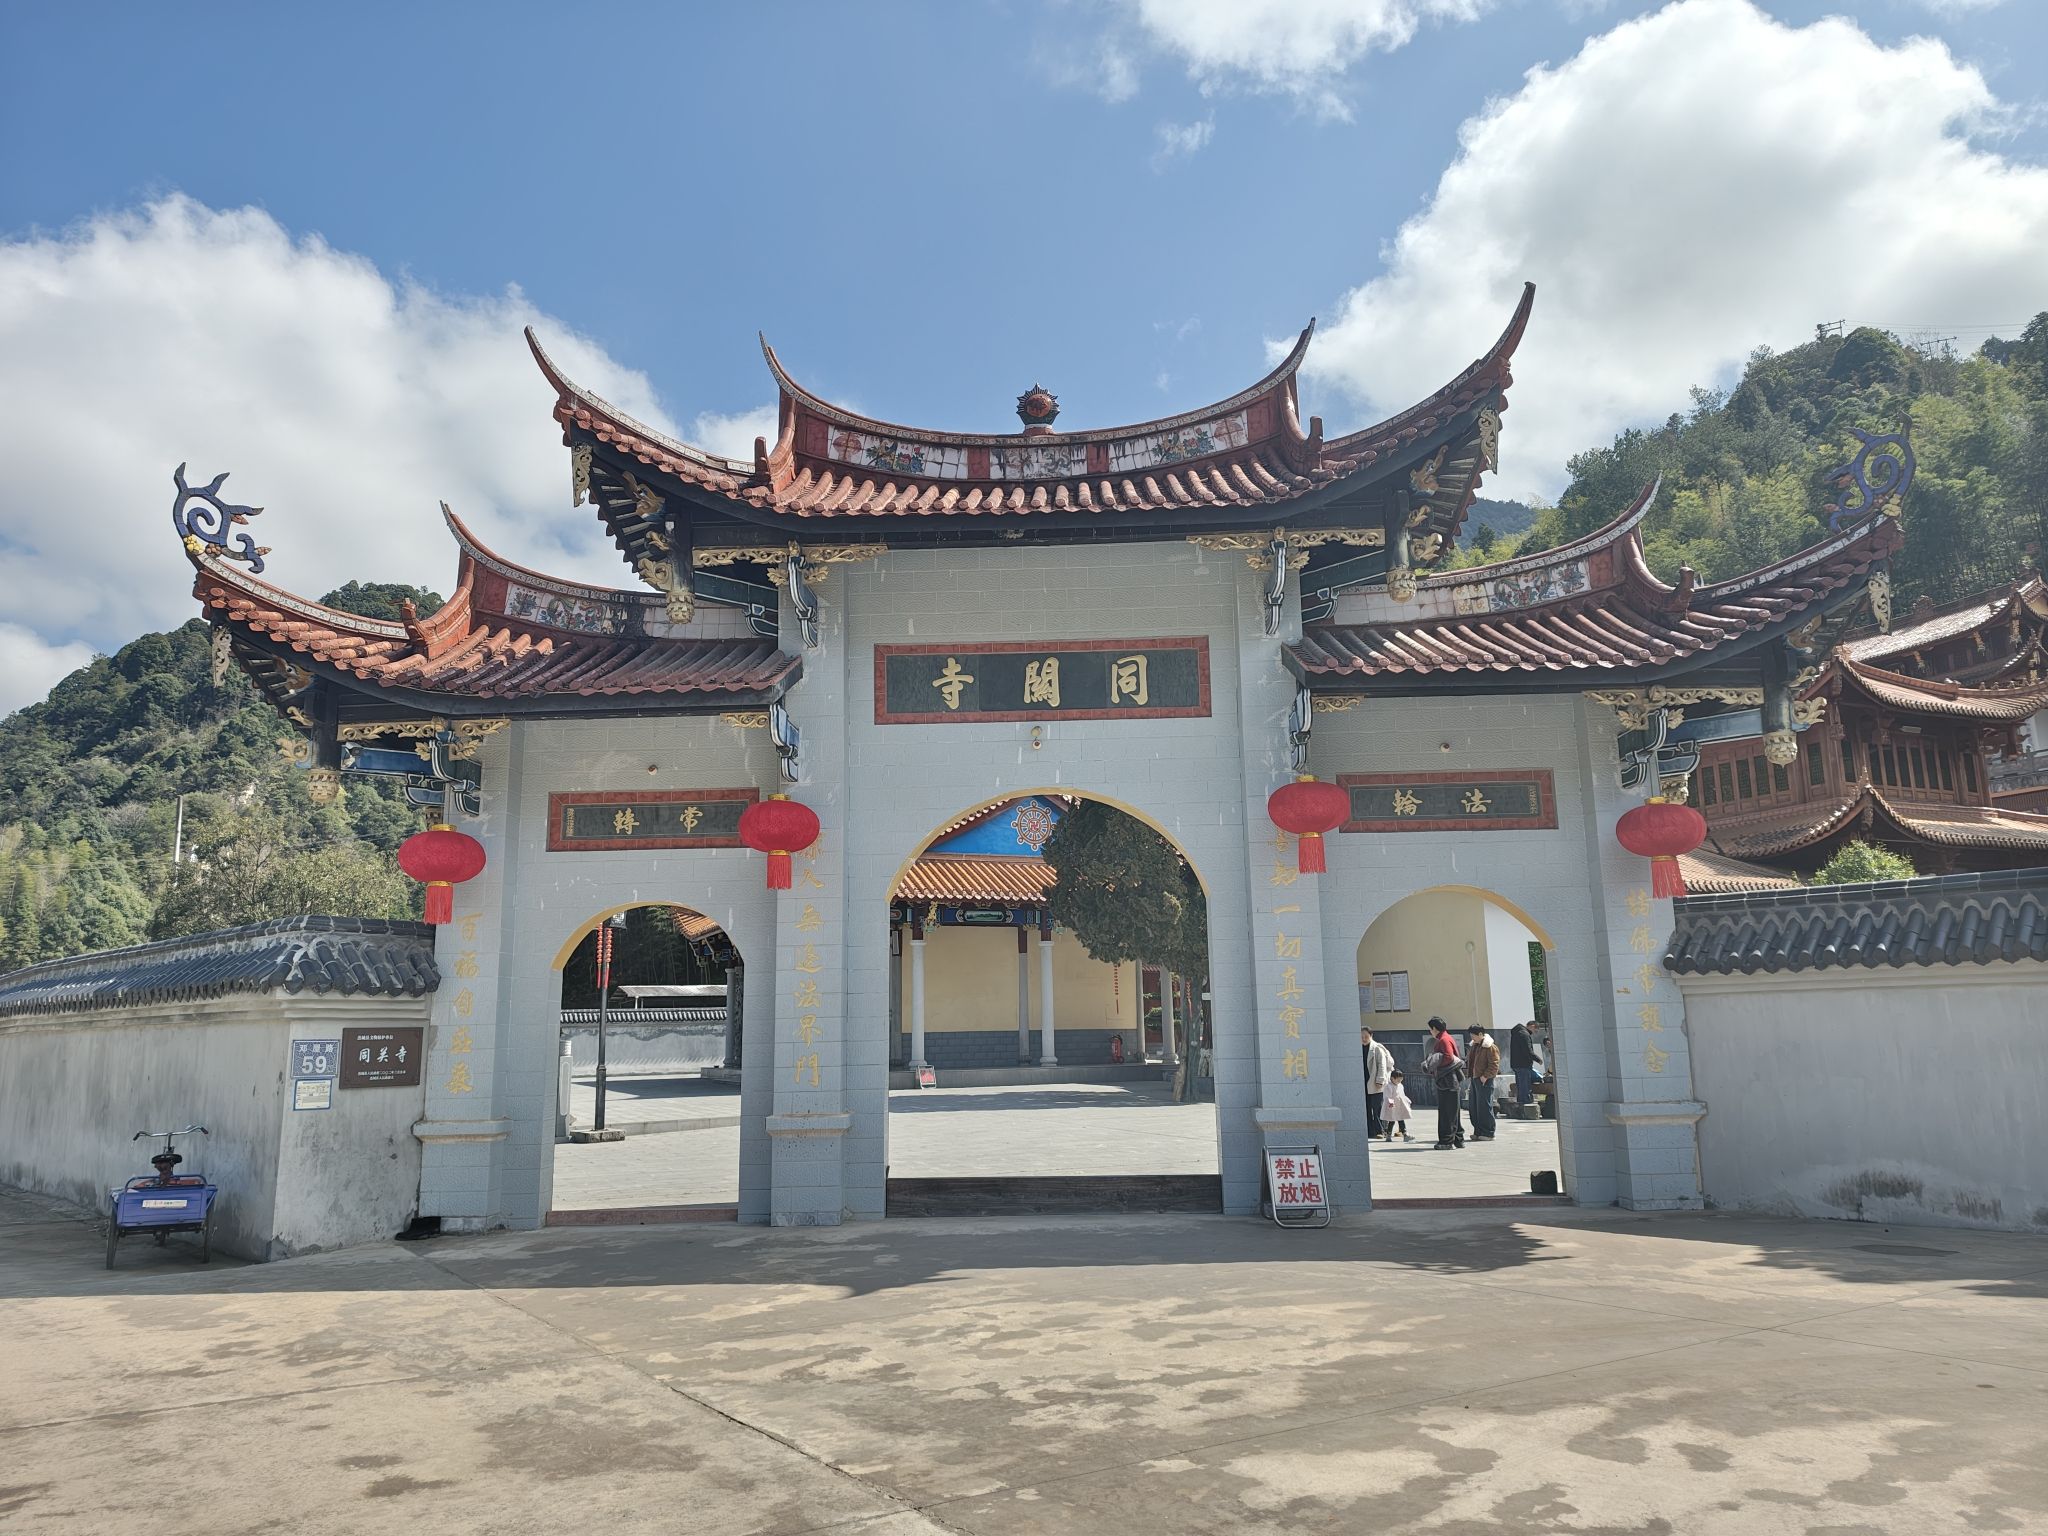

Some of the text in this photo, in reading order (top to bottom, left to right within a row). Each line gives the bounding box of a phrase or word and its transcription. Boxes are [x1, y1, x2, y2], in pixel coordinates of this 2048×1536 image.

[1391, 788, 1492, 816] 法輪
[612, 806, 704, 835] 常轉
[302, 1055, 327, 1074] 59
[1275, 1158, 1318, 1179] 禁止
[1278, 1182, 1322, 1204] 放炮
